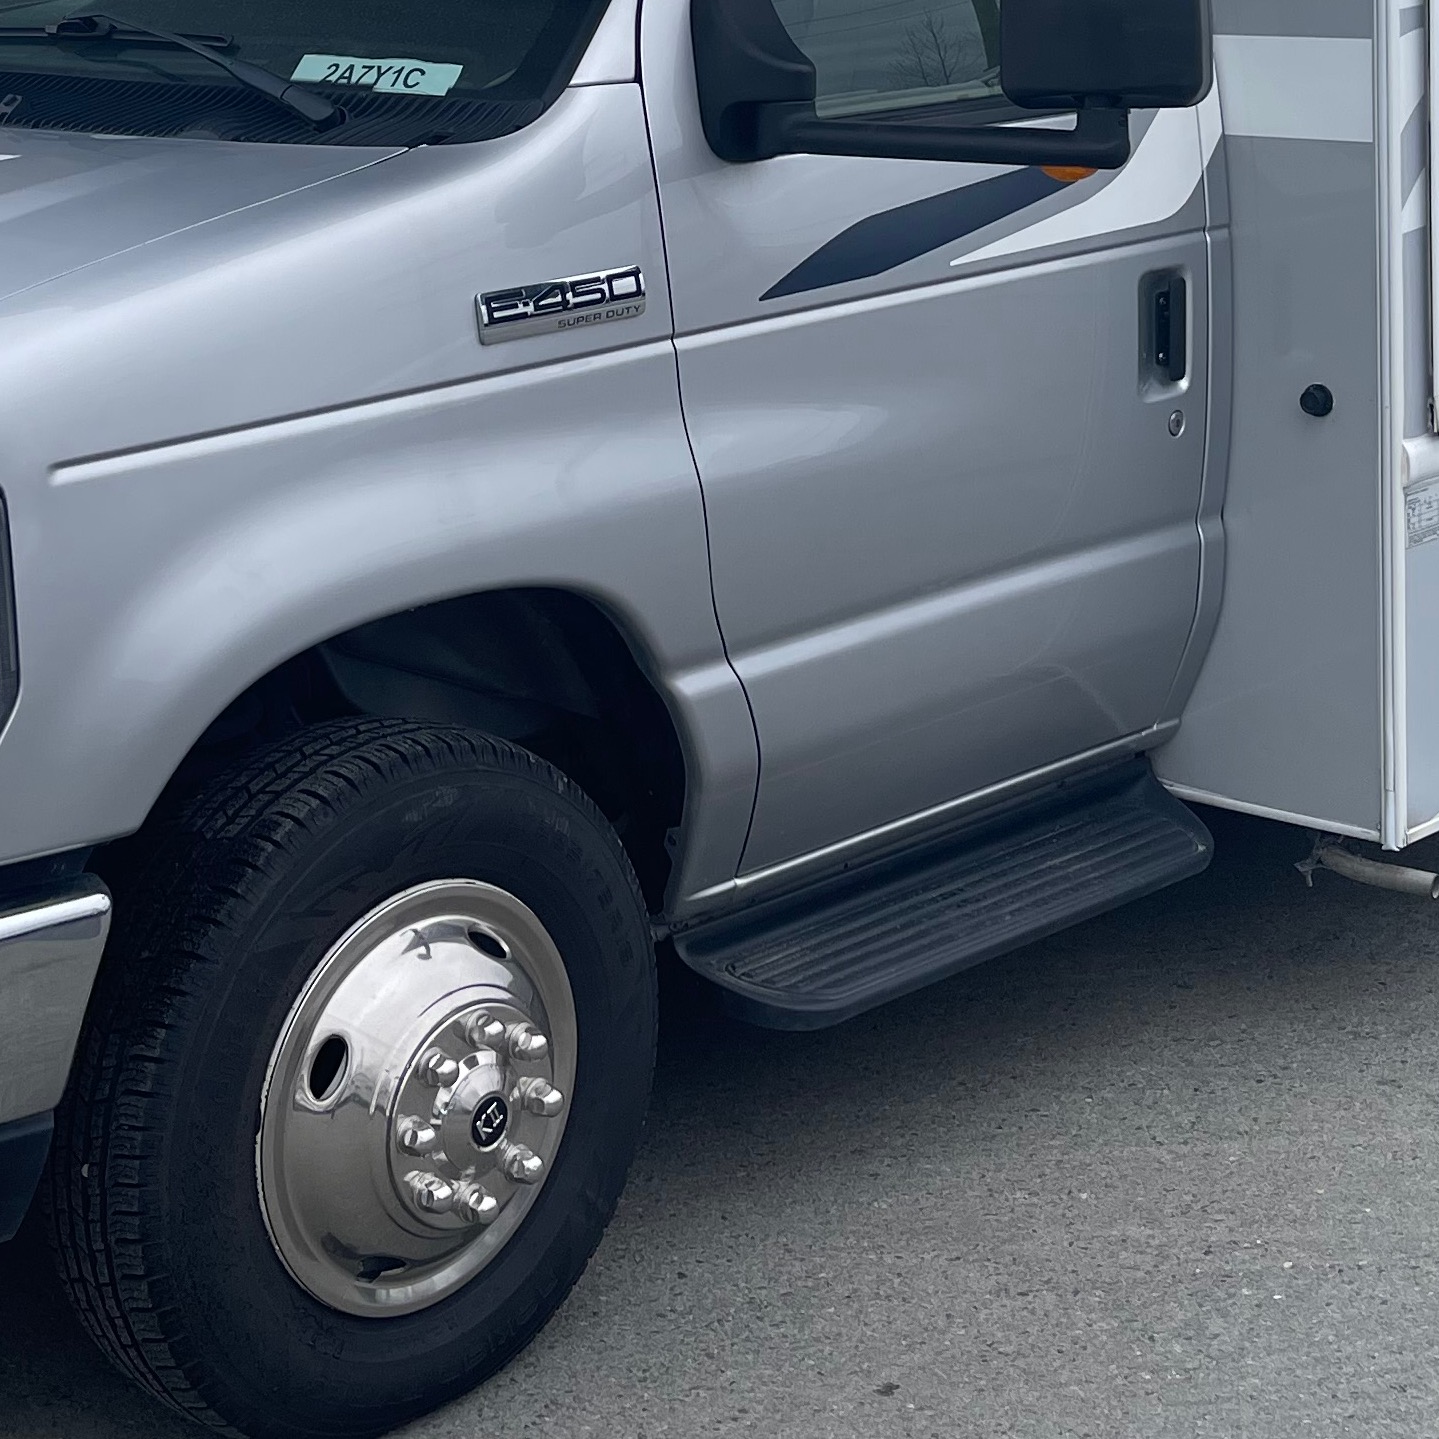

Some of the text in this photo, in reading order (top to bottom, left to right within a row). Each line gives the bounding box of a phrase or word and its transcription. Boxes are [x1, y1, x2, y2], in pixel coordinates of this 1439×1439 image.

[319, 63, 426, 89] 2A7Y1C
[557, 304, 642, 329] SUPER DUTY
